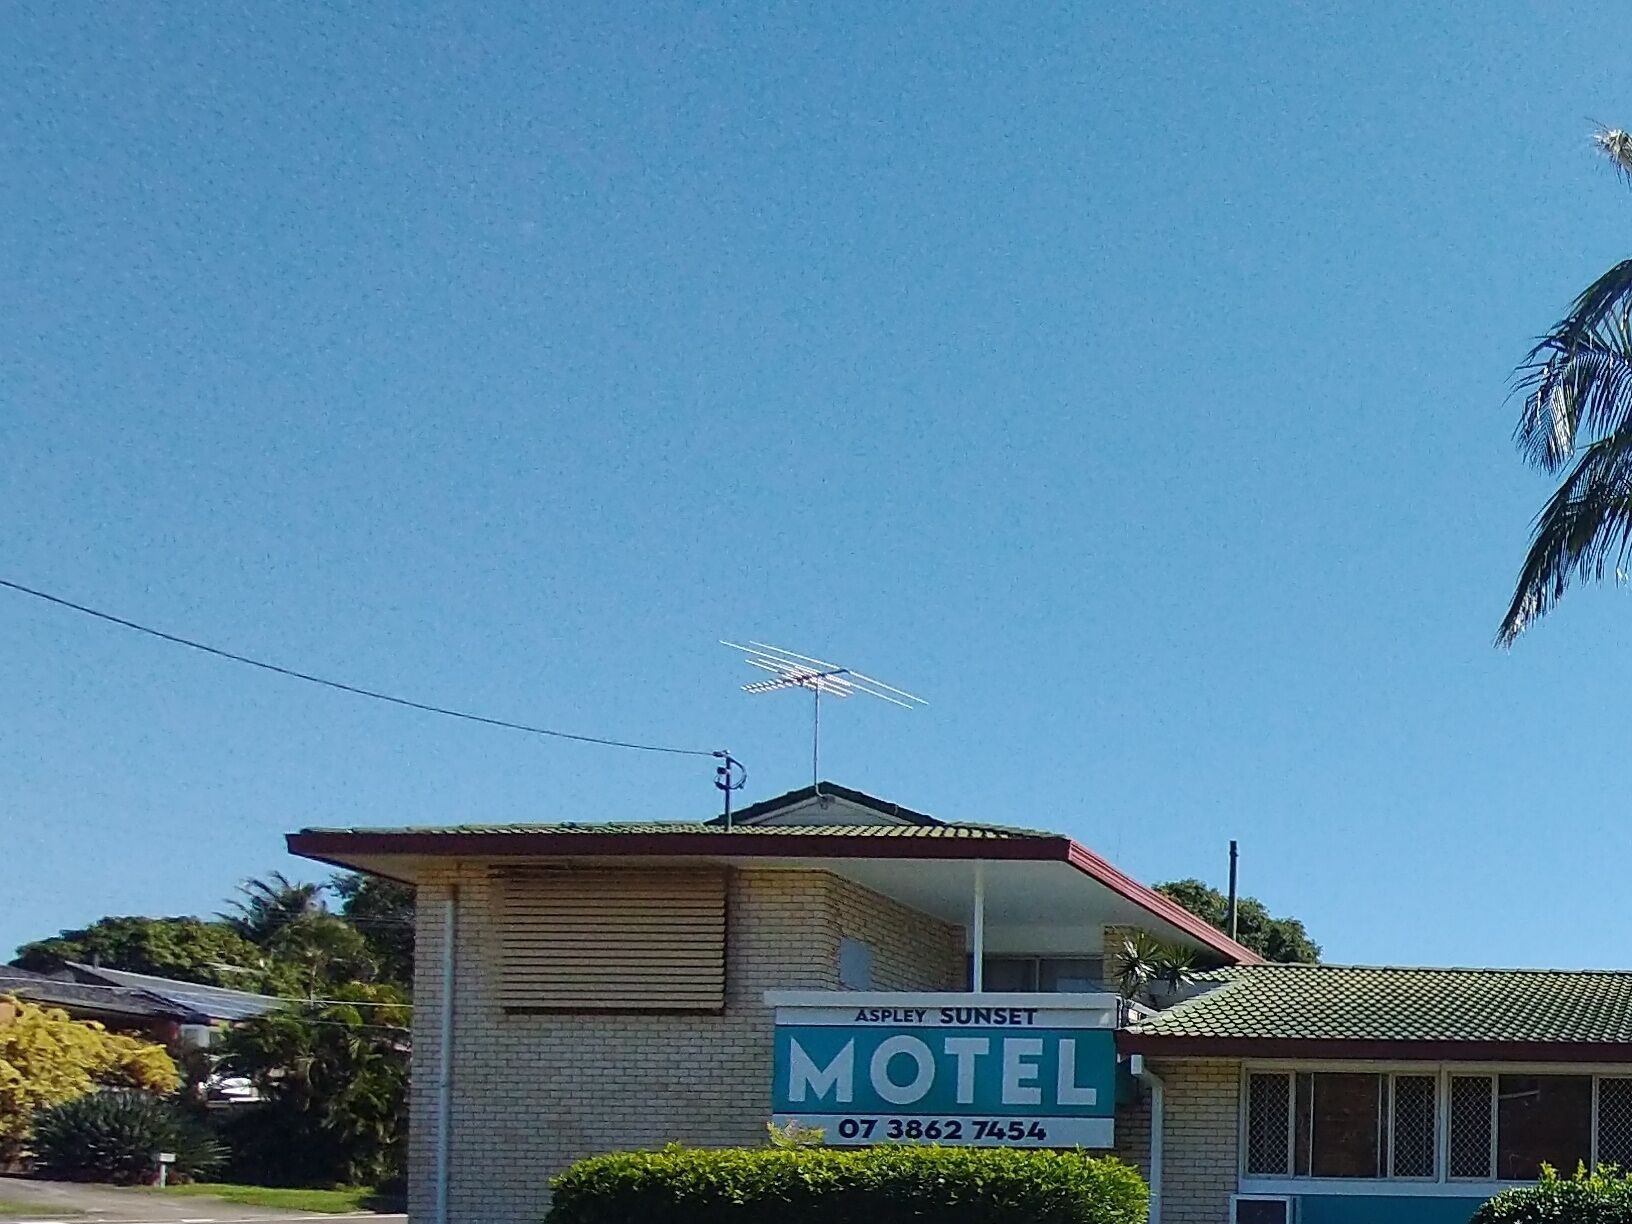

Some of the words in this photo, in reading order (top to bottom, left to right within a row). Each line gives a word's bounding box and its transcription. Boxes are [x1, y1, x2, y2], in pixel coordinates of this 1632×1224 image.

[855, 1008, 927, 1023] ASPLEY
[940, 1007, 1037, 1025] SUNSET
[788, 1034, 1097, 1106] MOTEL
[838, 1119, 878, 1139] 07
[887, 1119, 963, 1140] 3862
[972, 1120, 1046, 1141] 7454
